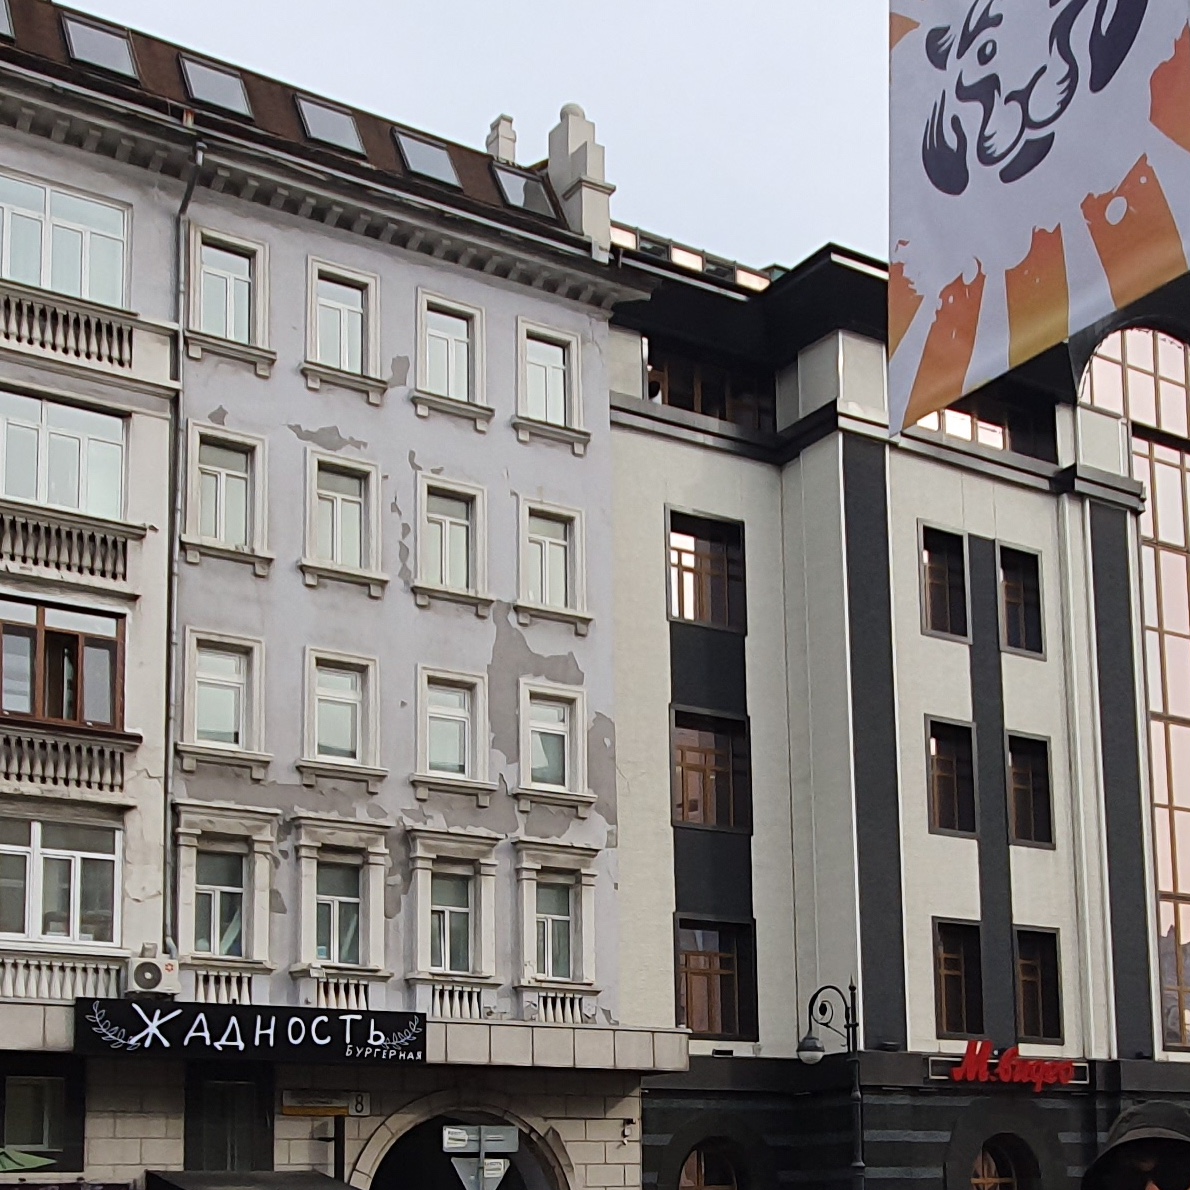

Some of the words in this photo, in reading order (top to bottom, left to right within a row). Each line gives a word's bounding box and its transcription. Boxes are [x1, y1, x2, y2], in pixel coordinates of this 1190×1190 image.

[129, 1002, 386, 1051] ЖАДНОСТЬ
[345, 1044, 423, 1061] БУРГЕРНАЯ
[355, 1094, 364, 1113] 8
